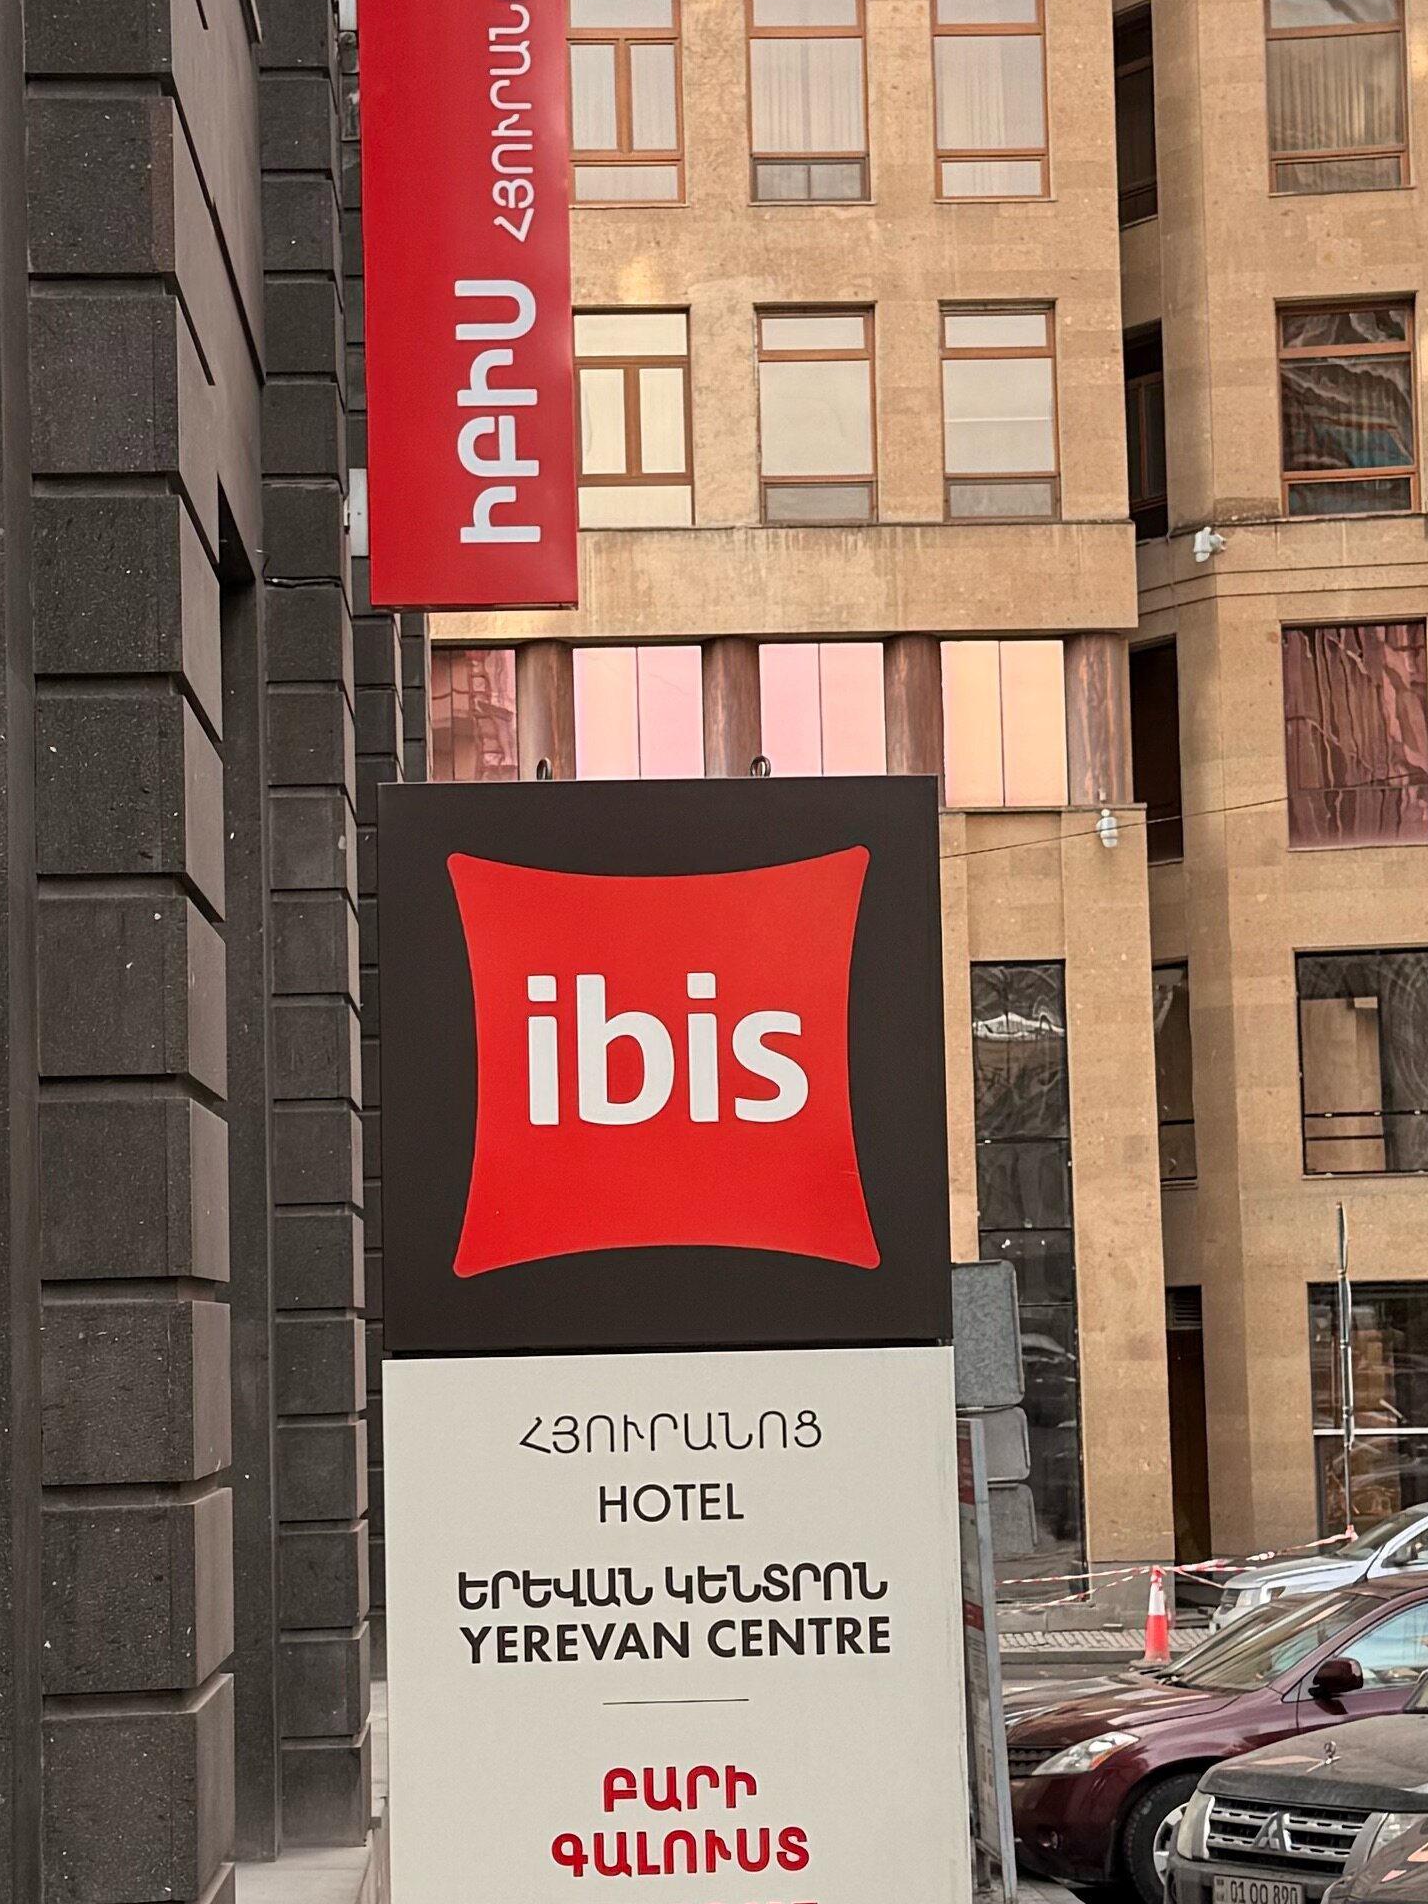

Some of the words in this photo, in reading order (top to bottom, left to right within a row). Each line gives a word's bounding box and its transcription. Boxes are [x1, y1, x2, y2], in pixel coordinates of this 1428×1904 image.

[455, 280, 540, 542] ԻԲԻՍ
[528, 973, 809, 1126] ibis
[519, 1410, 822, 1454] ՀՅՈՒՐԱՆՈՑ
[599, 1483, 744, 1523] HOTEL
[458, 1567, 653, 1611] ԵՐԵՎԱՆ
[665, 1561, 888, 1604] ԿԵՆՏՐՈՆ
[460, 1621, 690, 1664] YEREVAN
[707, 1615, 891, 1658] CENTRE
[602, 1764, 758, 1813] ԲԱՐԻ
[550, 1825, 810, 1878] ԳԱԼՈՒՍՏ
[1230, 1880, 1246, 1904] 01
